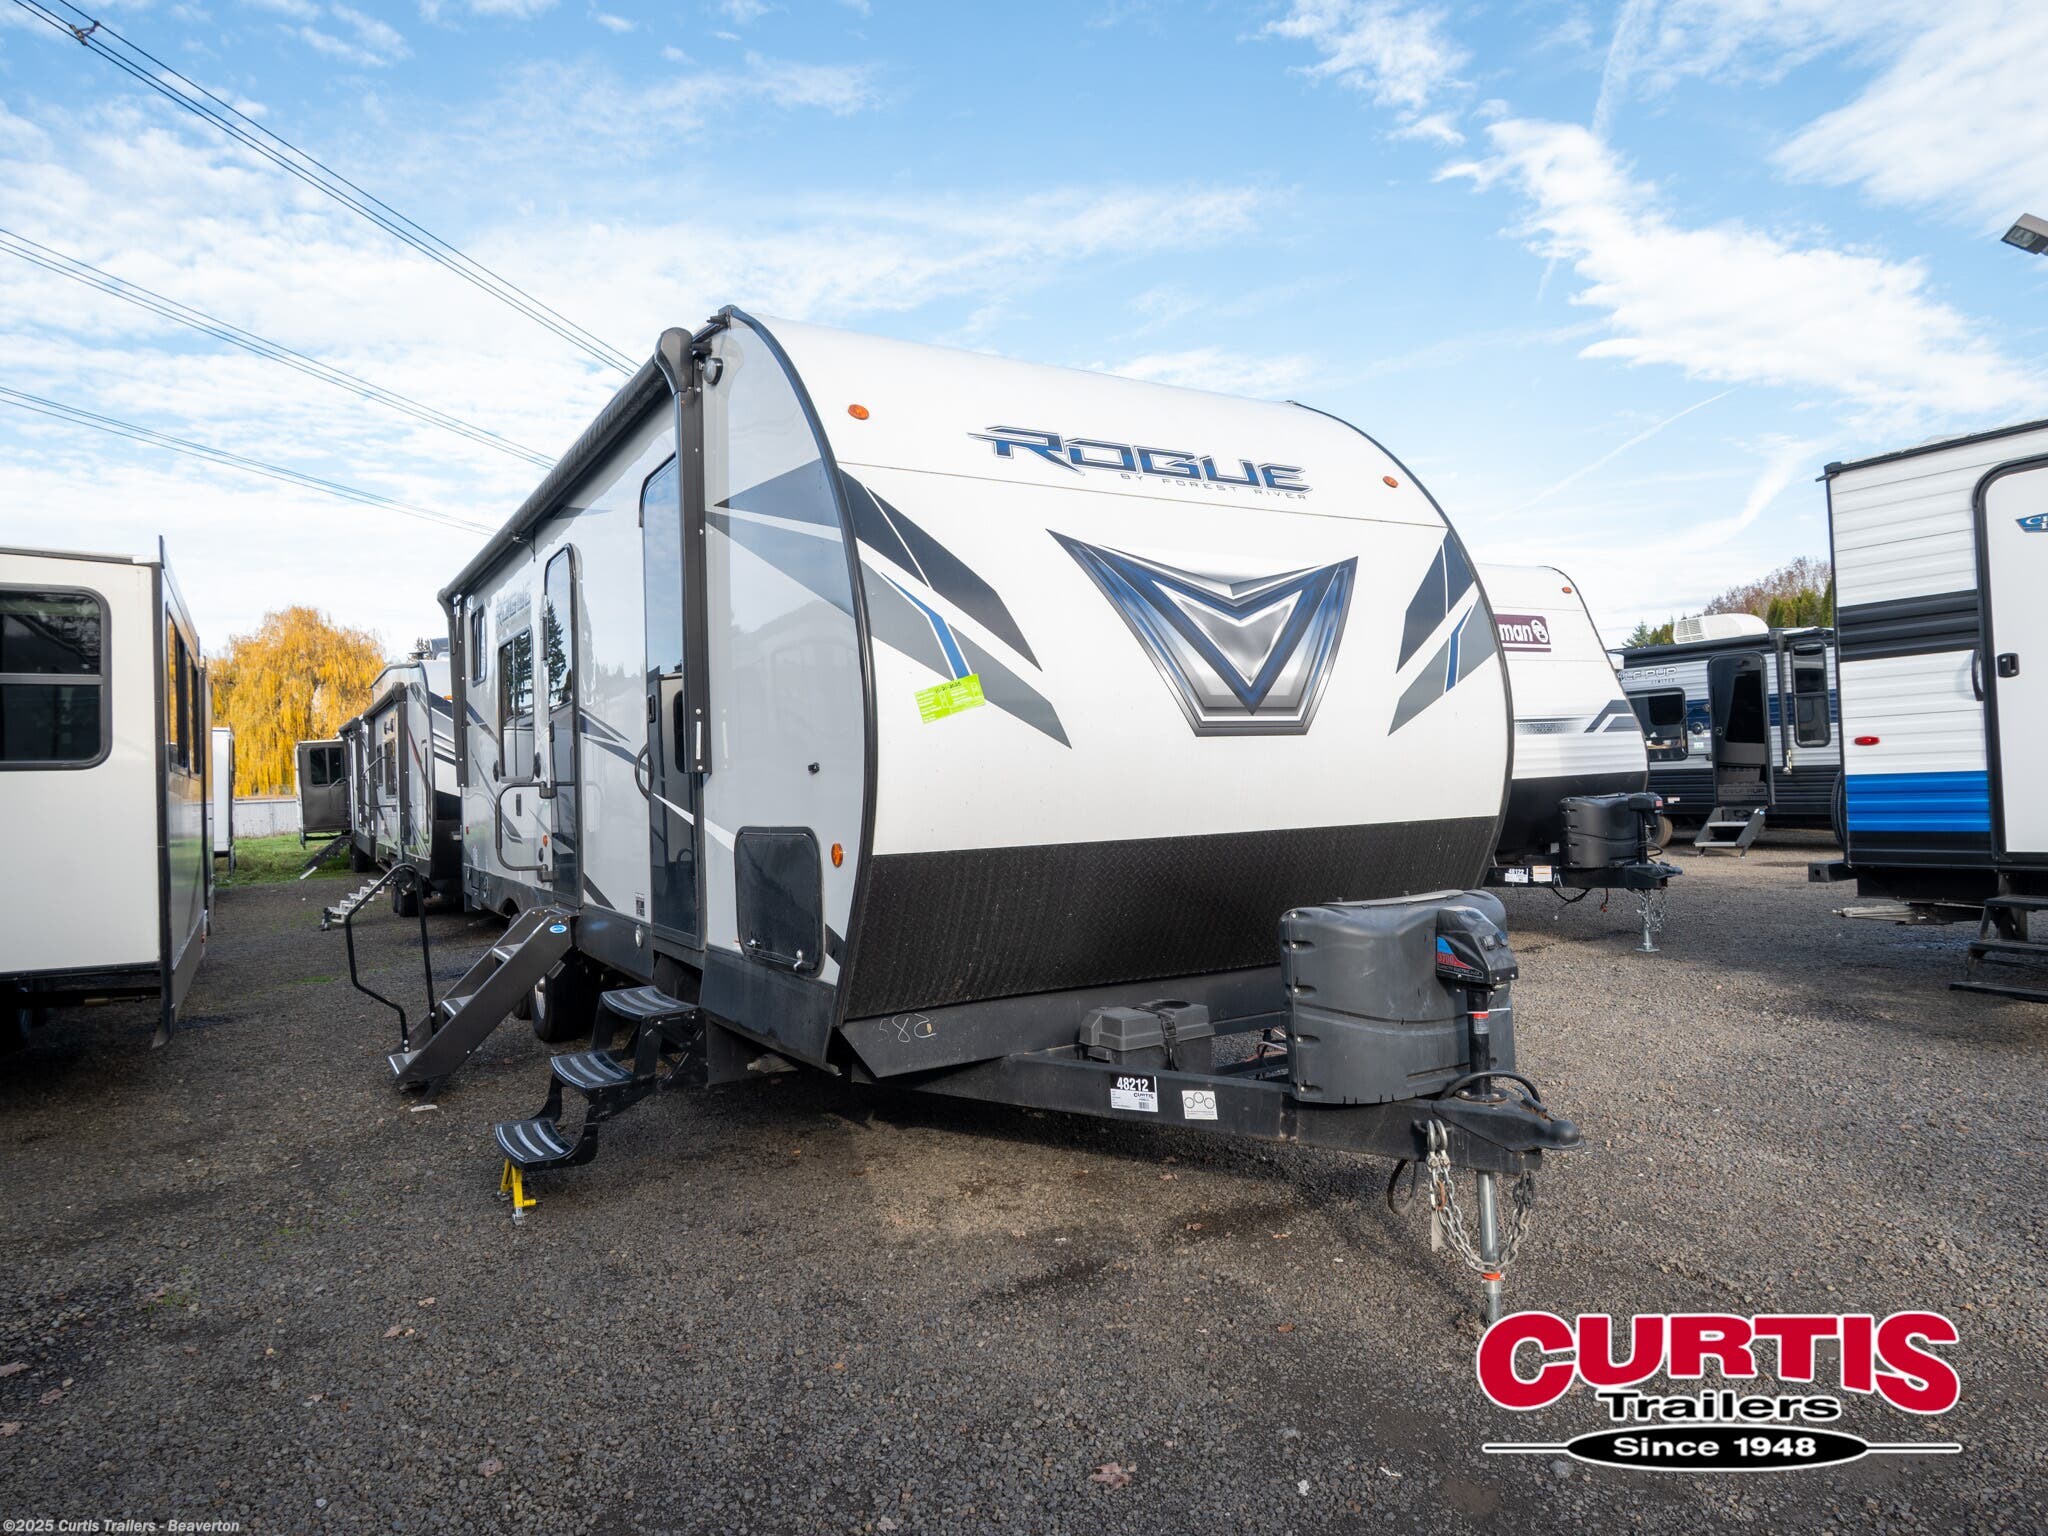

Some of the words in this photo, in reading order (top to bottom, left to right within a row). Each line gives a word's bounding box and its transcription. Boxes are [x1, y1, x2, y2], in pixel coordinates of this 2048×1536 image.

[967, 426, 1312, 494] ROGUE
[1120, 473, 1144, 482] BY
[1161, 477, 1238, 492] FOREST
[1253, 488, 1307, 500] RIVER
[1644, 666, 1678, 680] PUP
[1116, 1076, 1149, 1092] 48212
